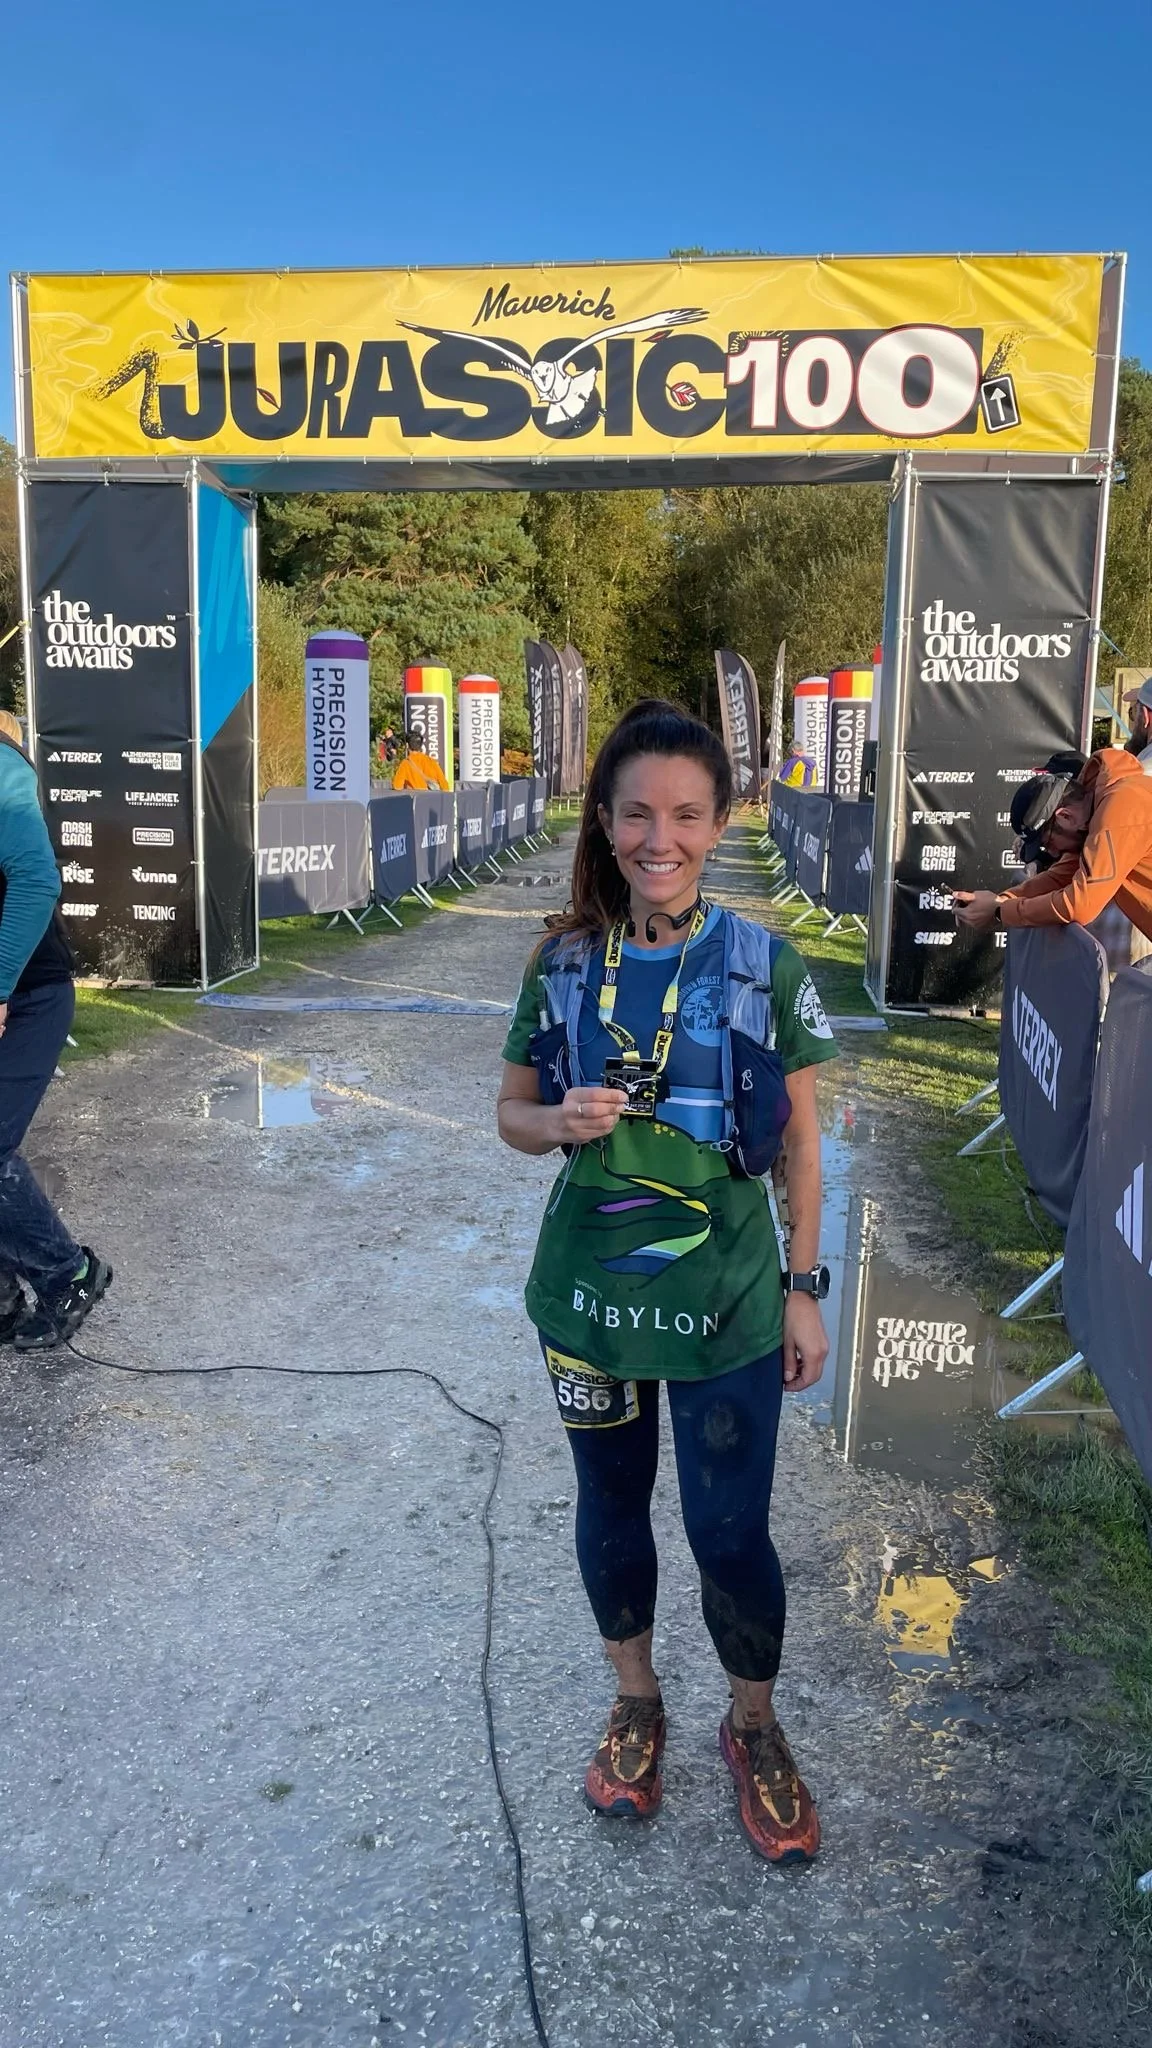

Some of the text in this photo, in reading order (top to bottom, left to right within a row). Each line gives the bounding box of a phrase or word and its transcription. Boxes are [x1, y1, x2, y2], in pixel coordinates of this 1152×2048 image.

[472, 283, 616, 327] Maverick
[146, 325, 980, 441] JURASSIC 100
[42, 590, 90, 623] the
[921, 600, 975, 635] the
[48, 614, 176, 648] outdoors
[925, 623, 1071, 658] outdoors
[46, 645, 134, 669] awaits
[920, 657, 1020, 682] awaits
[311, 667, 327, 791] HYDRATION
[328, 667, 346, 791] PRECISION
[731, 667, 751, 760] TERREX
[471, 698, 482, 777] HYDRATION
[483, 699, 494, 777] PRECISION
[834, 709, 854, 794] ECISION
[853, 709, 866, 782] HYDRATION
[61, 751, 103, 764] TERREX
[927, 771, 976, 783] TERREX
[61, 821, 93, 834] MASH
[61, 832, 93, 847] GANG
[427, 824, 448, 847] TERREX
[257, 844, 336, 876] TERREX
[385, 833, 407, 860] TERREX
[922, 845, 957, 858] MASH
[921, 857, 956, 872] GANG
[132, 905, 176, 921] TENZING
[1018, 991, 1062, 1111] TERREX
[573, 1289, 719, 1336] BABYLON
[558, 1380, 612, 1411] 556
